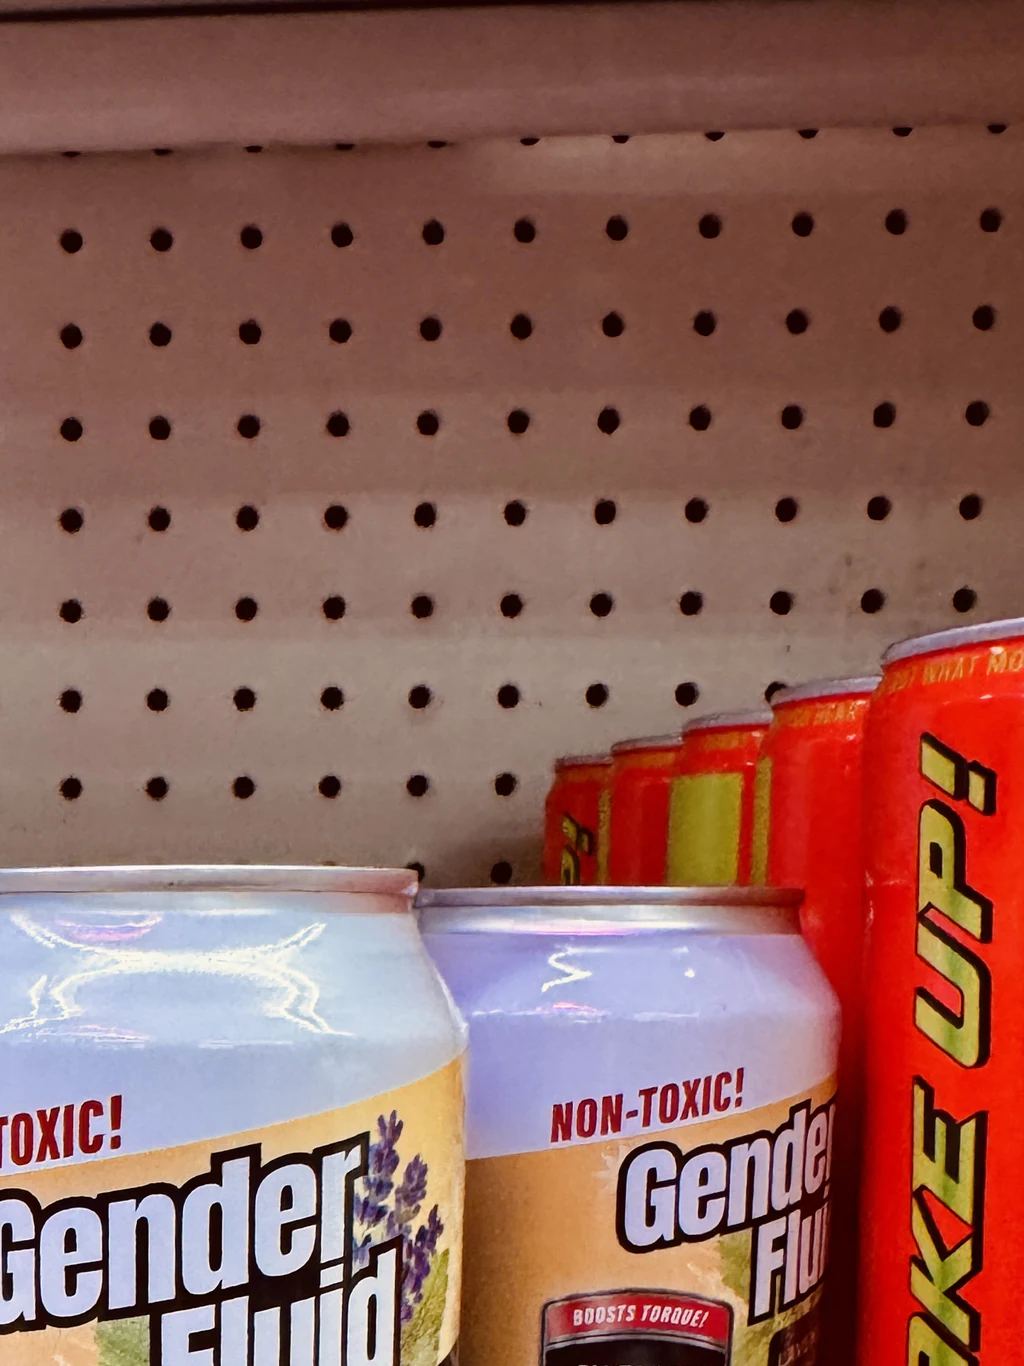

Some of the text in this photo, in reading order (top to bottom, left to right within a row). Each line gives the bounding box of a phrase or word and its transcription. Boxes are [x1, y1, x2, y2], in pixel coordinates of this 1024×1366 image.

[914, 731, 997, 1069] UP!
[550, 1067, 744, 1143] NON-TOXIC!
[747, 1198, 832, 1327] Flu
[573, 1304, 709, 1329] BOOSTS TORQUE!
